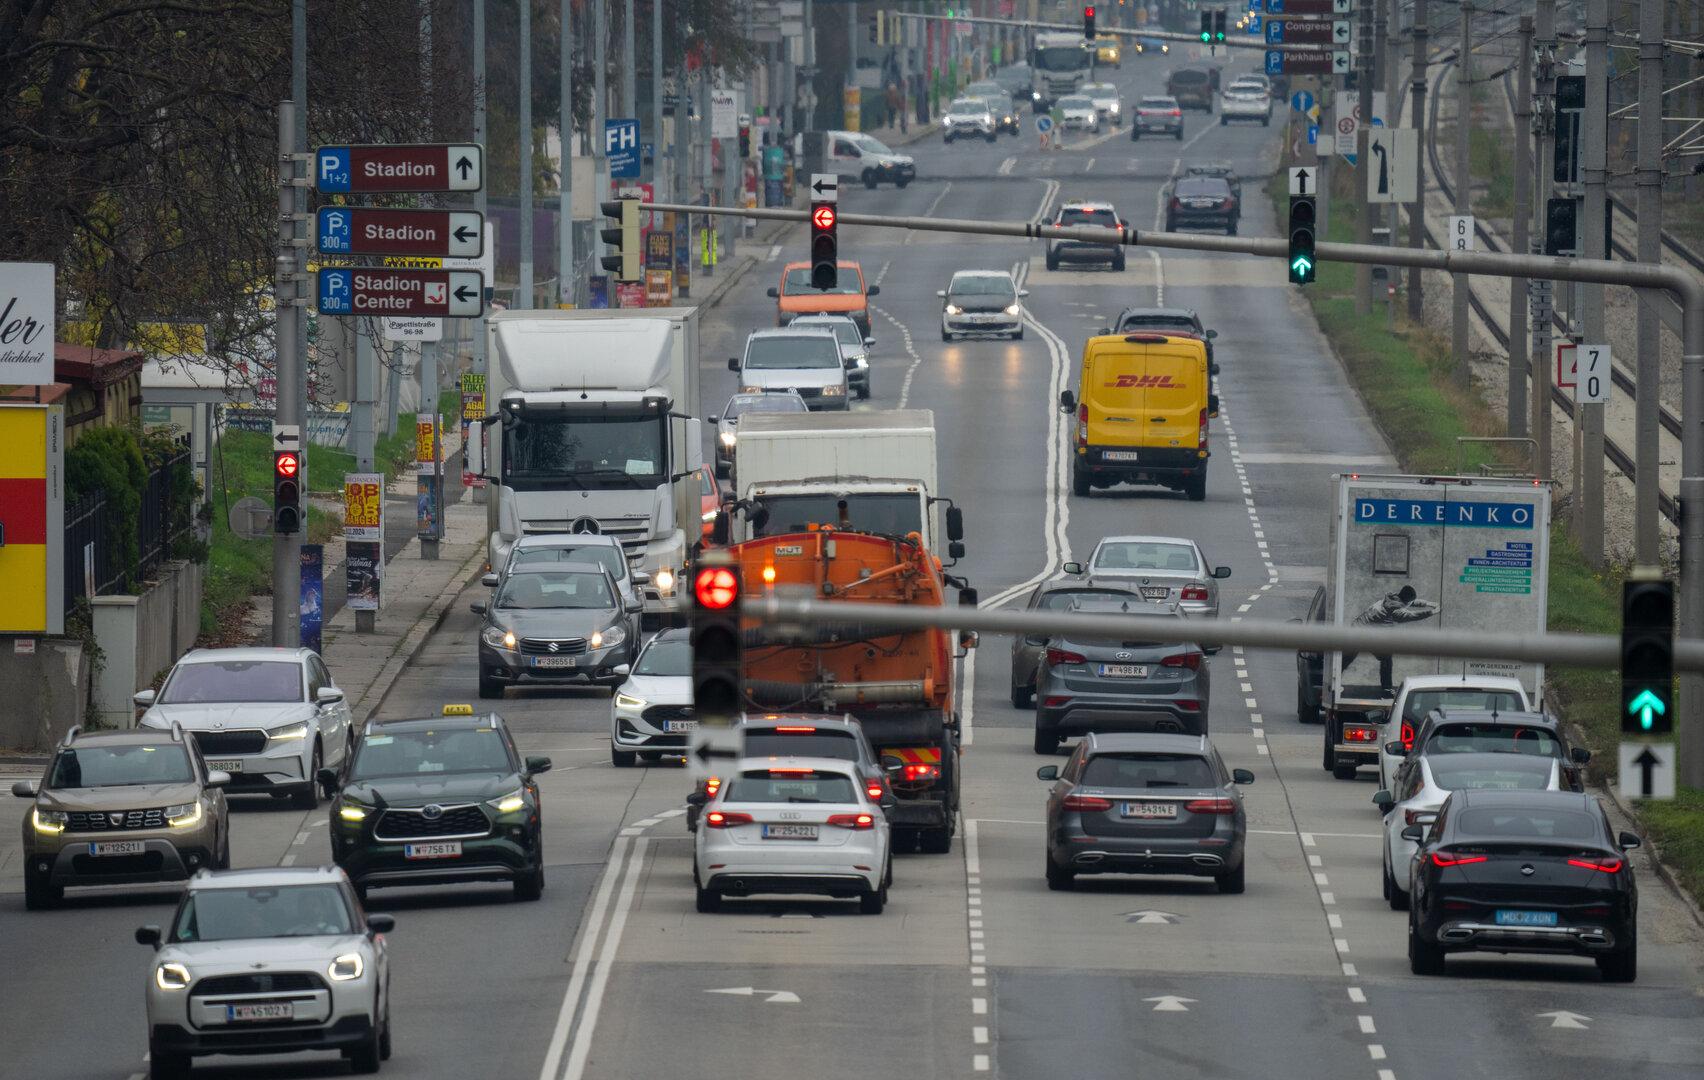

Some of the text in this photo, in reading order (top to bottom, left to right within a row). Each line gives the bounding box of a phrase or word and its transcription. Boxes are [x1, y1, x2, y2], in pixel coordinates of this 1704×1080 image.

[1285, 21, 1331, 31] Congress
[1284, 52, 1323, 61] Parkhaus
[1325, 52, 1332, 60] D
[606, 126, 635, 152] FH
[364, 162, 435, 177] Stadion
[365, 224, 436, 240] Stadion
[322, 236, 339, 249] 300
[354, 276, 420, 291] Stadion
[322, 297, 340, 310] 300
[354, 294, 412, 309] Center
[1114, 375, 1176, 389] DHL
[1362, 503, 1528, 524] DERENKO
